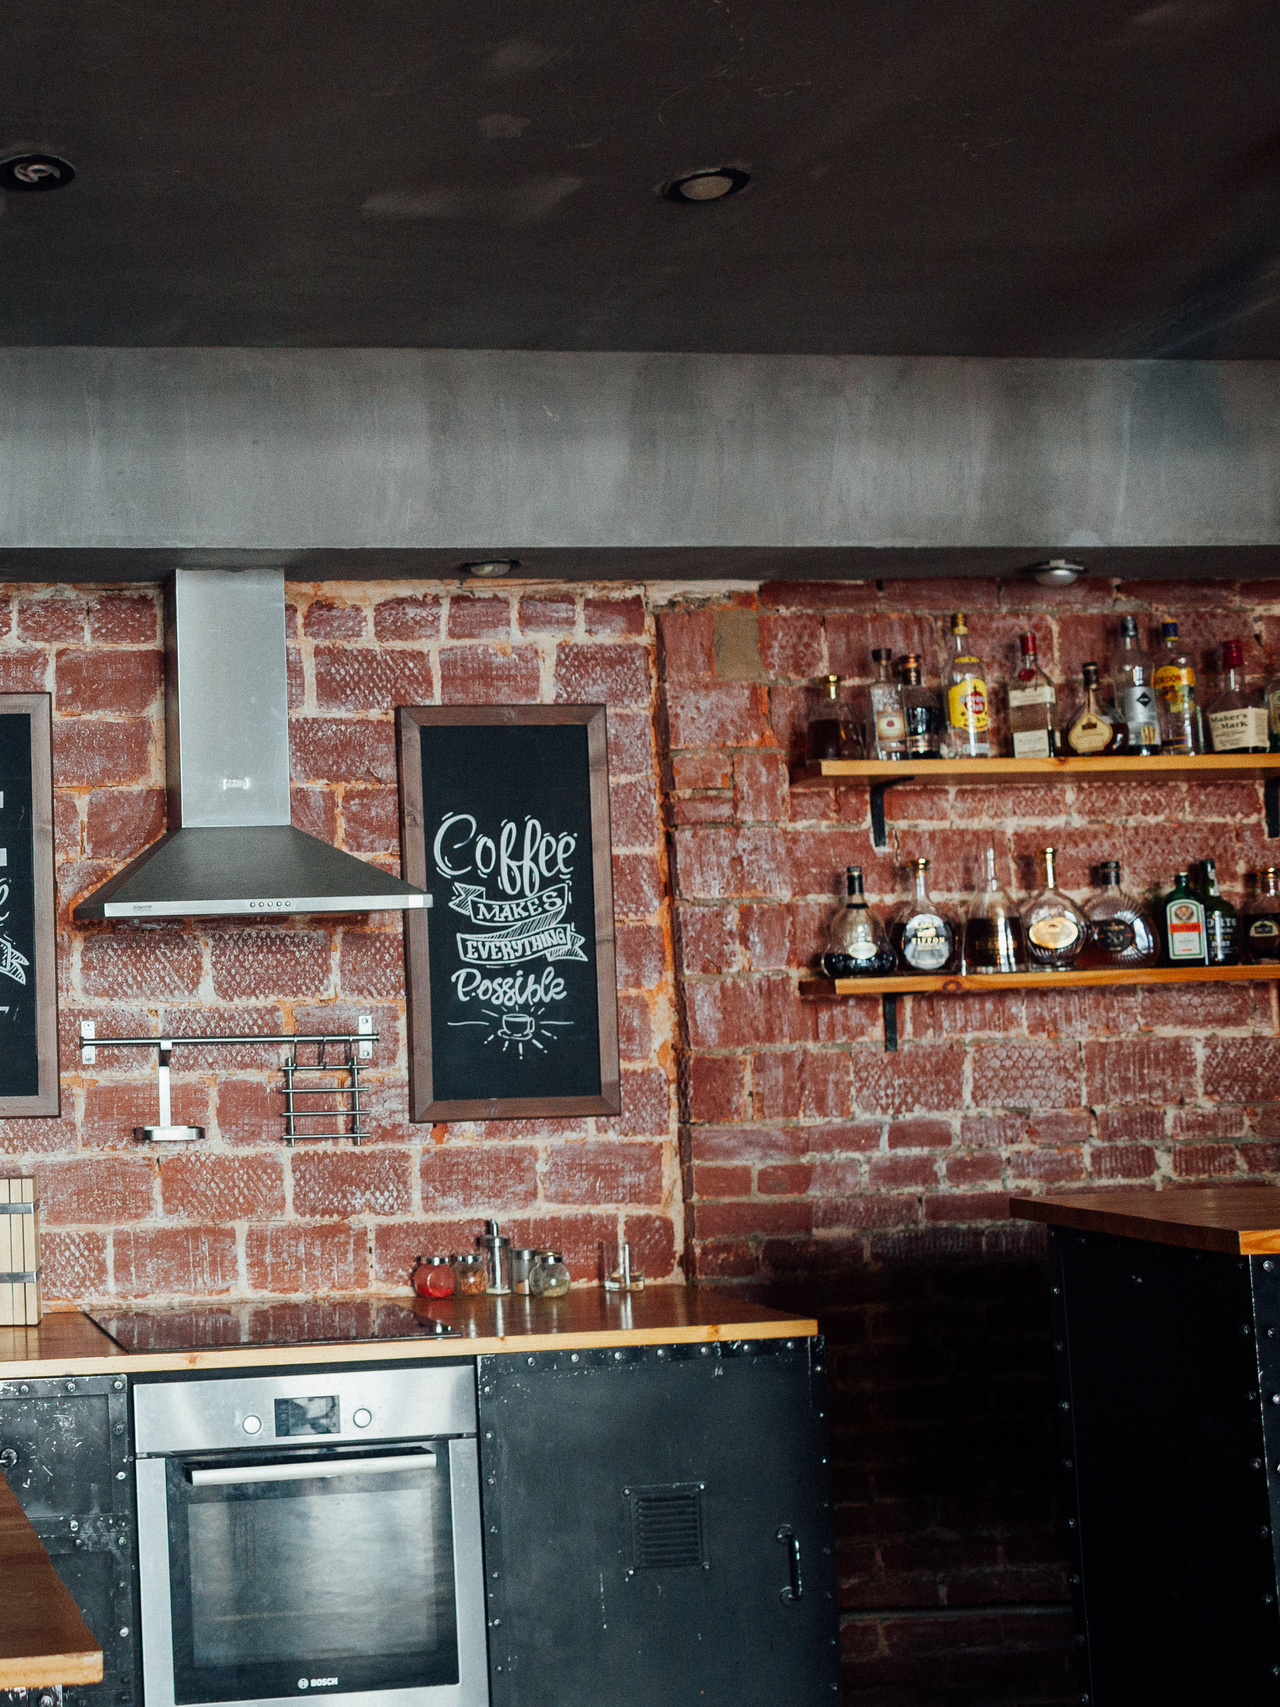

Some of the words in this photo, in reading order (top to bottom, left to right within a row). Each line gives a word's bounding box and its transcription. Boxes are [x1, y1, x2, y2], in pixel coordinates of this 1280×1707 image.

[434, 813, 577, 896] Coffee
[477, 891, 563, 922] MAKES
[465, 927, 567, 960] EVERYTHING
[451, 966, 567, 1006] Possible
[310, 1677, 339, 1687] BOSCH
